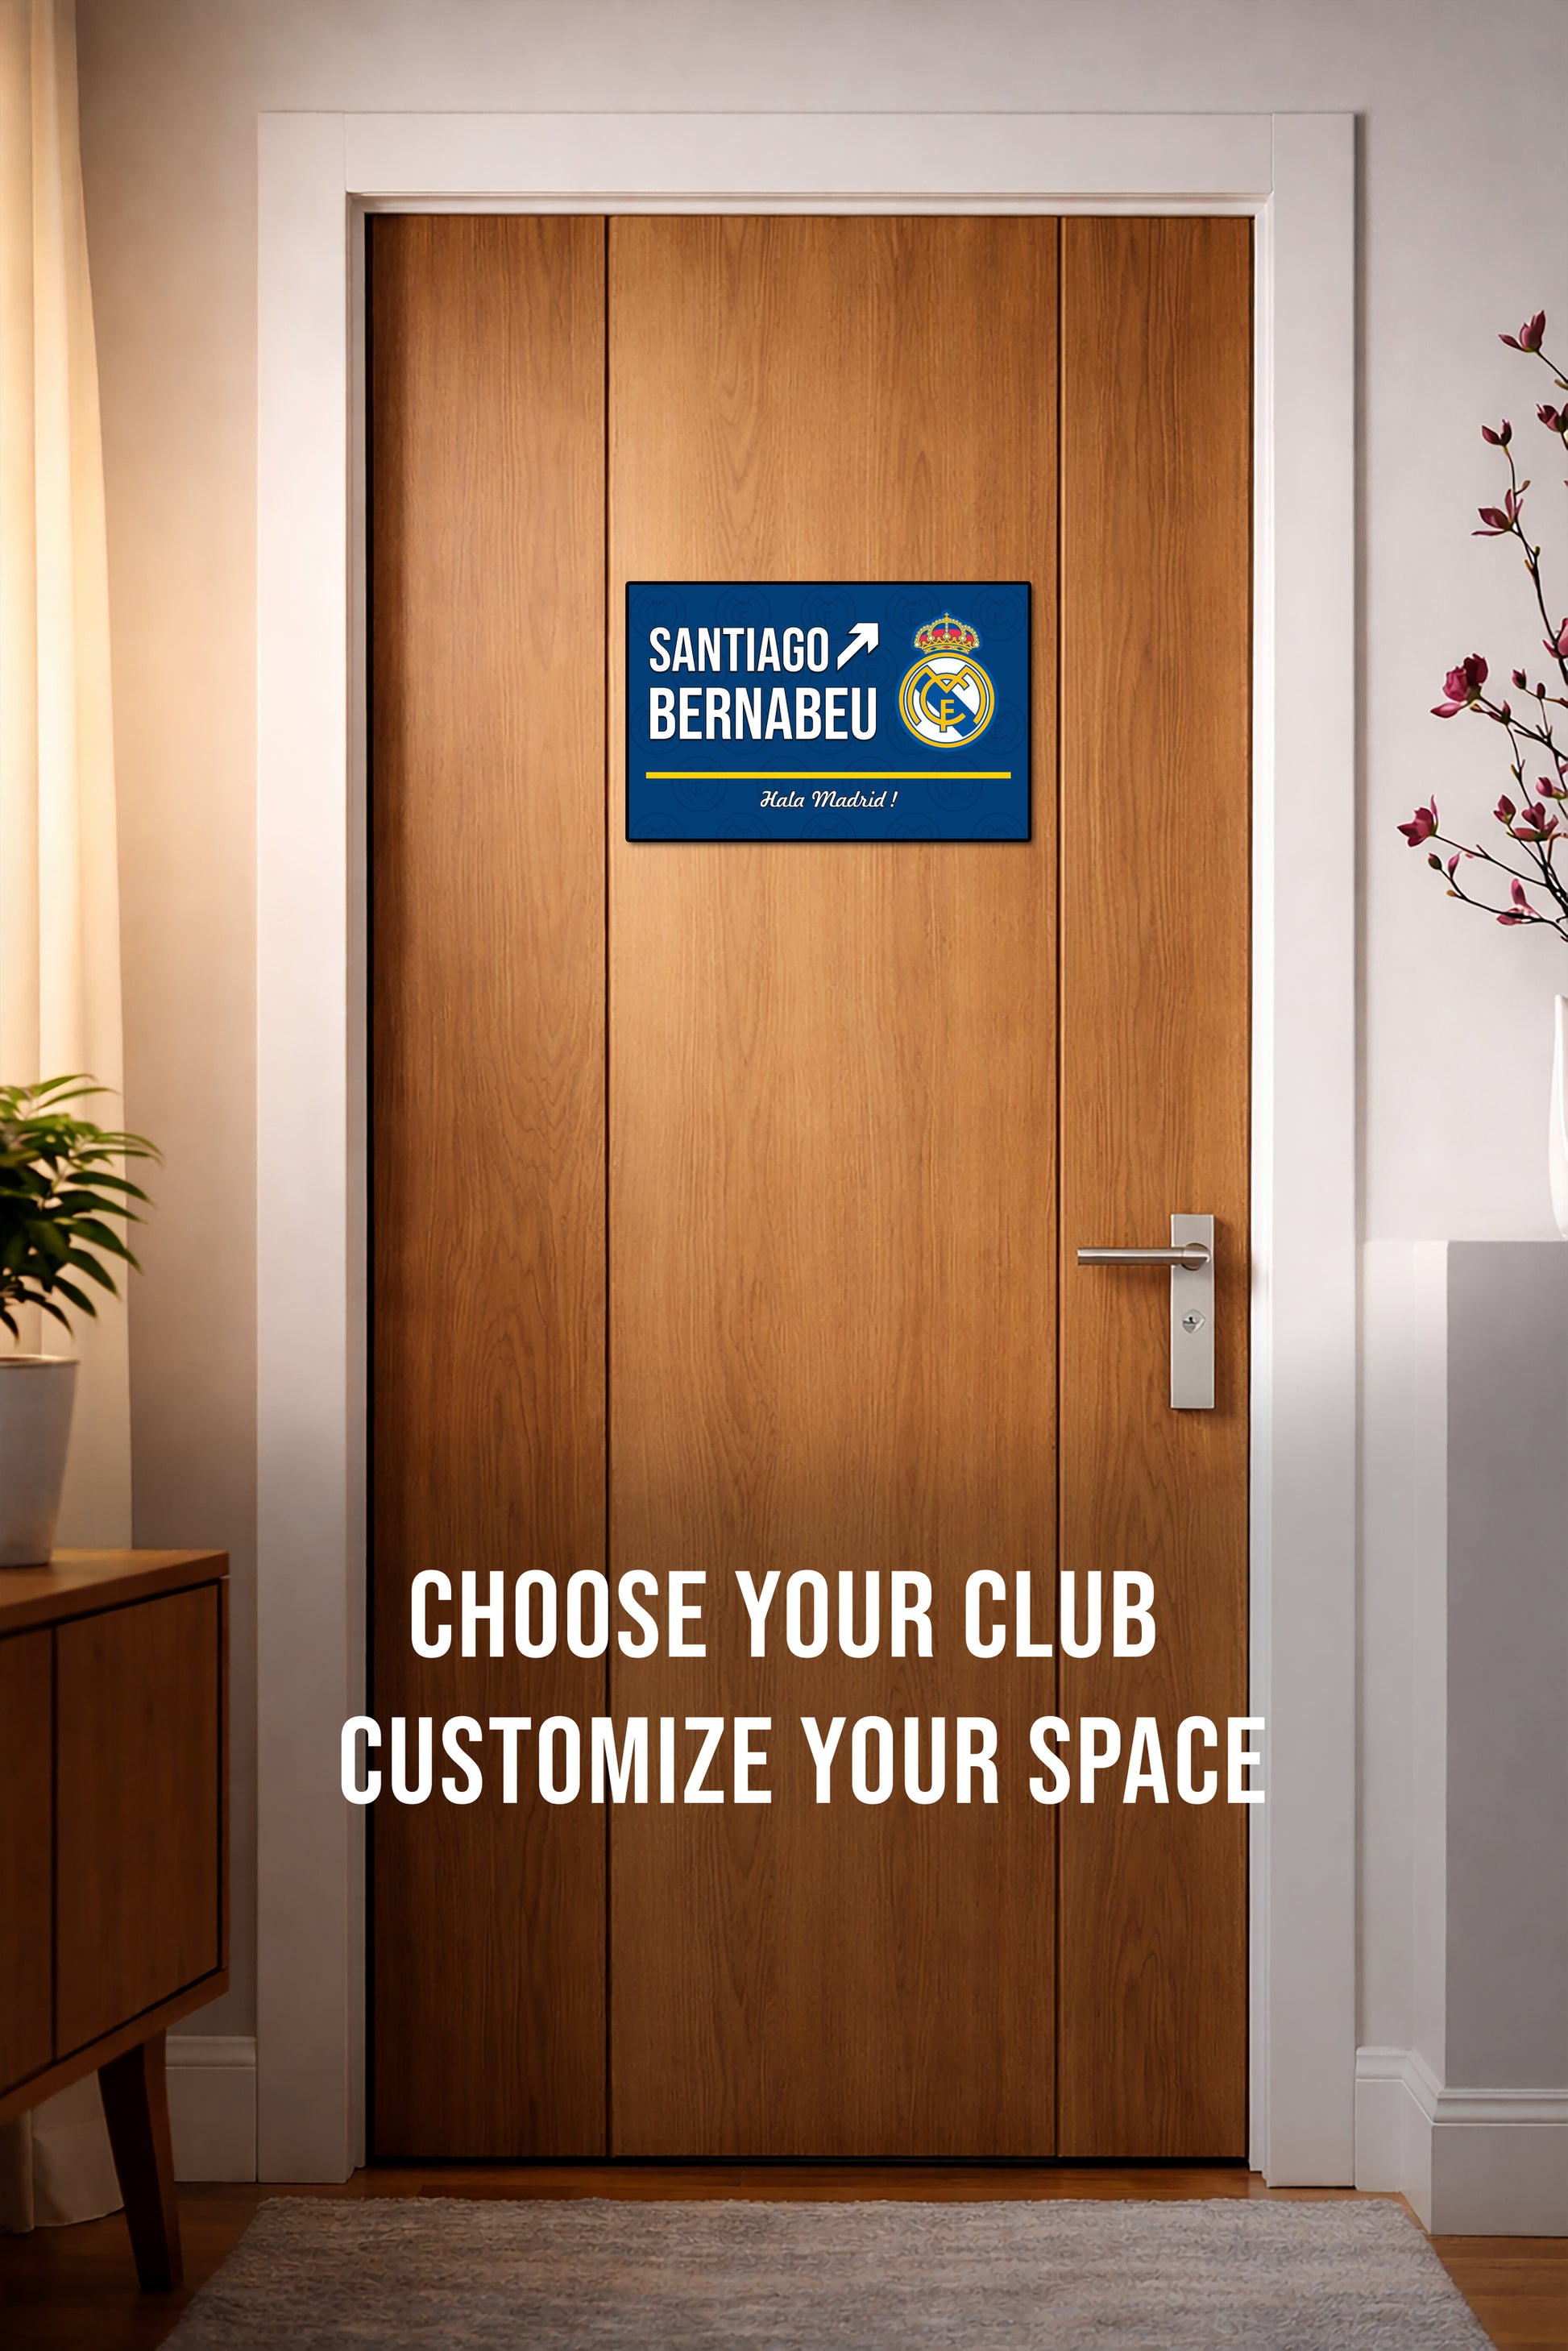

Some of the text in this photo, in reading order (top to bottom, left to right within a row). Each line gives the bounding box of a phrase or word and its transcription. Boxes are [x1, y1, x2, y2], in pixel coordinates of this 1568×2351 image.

[649, 627, 829, 672] SANTIAGO
[649, 687, 877, 740] BERNABEU
[760, 790, 805, 807] Hala
